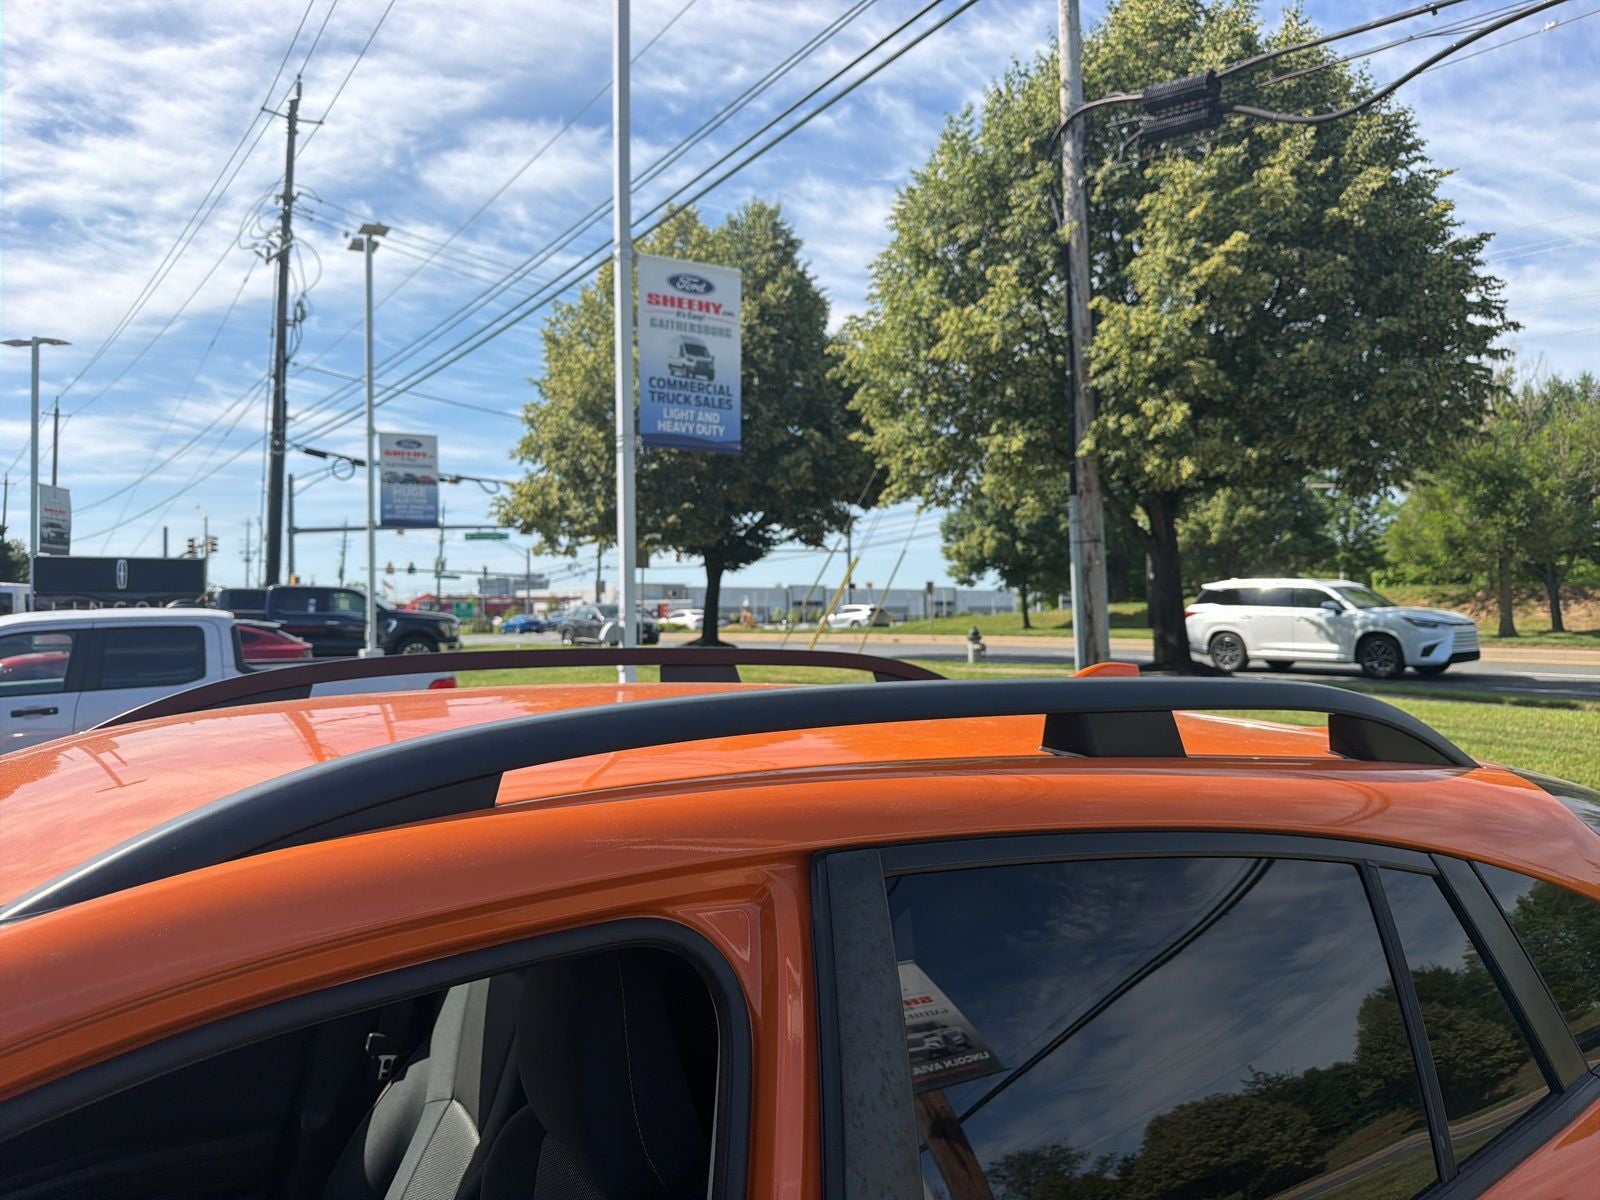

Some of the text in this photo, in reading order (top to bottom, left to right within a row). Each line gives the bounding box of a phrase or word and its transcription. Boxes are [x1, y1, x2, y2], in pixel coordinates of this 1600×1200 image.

[675, 277, 706, 292] Ford
[646, 292, 723, 315] SHEEHY
[648, 376, 733, 397] COMMERCIAL
[648, 389, 733, 410] TRUCK SALES
[663, 407, 720, 424] LIGHT AND
[657, 420, 725, 437] HEAVY DUTY
